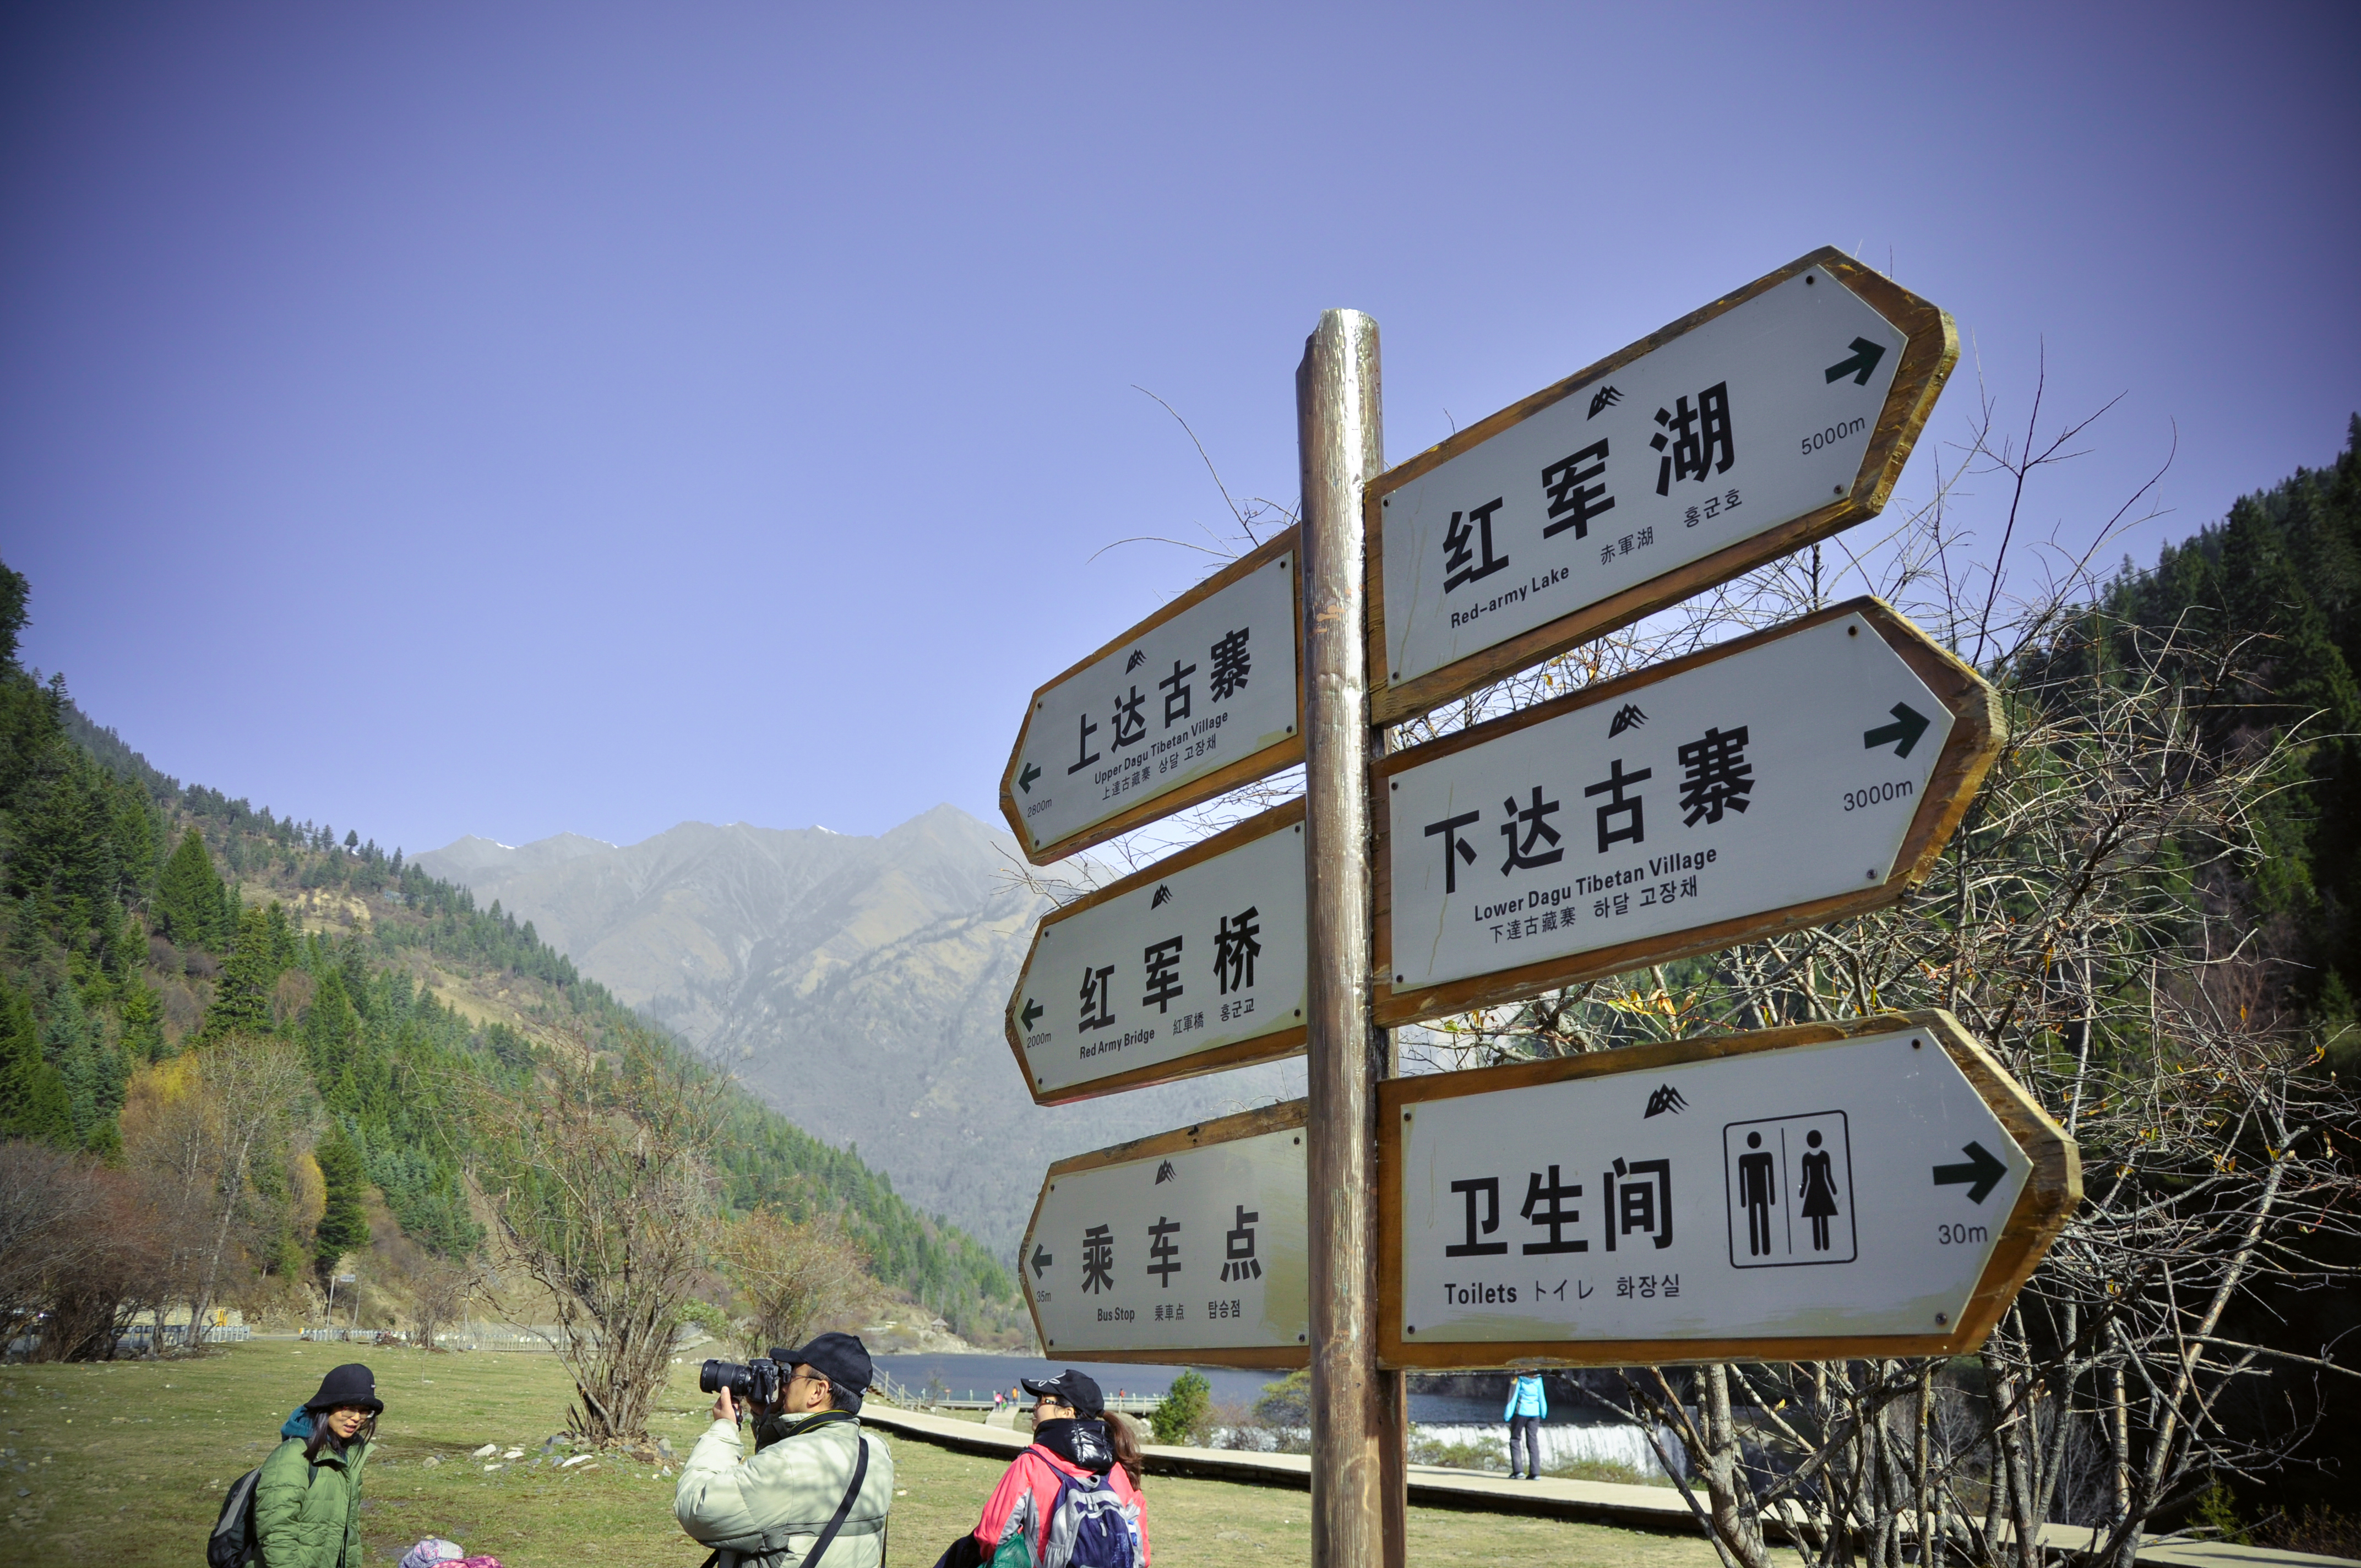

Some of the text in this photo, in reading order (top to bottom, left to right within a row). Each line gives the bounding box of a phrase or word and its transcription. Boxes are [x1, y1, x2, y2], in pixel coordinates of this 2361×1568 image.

[1802, 417, 1865, 455] 5000m
[1442, 380, 1735, 595] 红军湖
[1683, 488, 1742, 528] 홍군호
[1600, 526, 1653, 565] 赤軍湖
[1451, 567, 1569, 629] Red-army Lake
[1067, 626, 1252, 776] 上达古寨
[1095, 712, 1228, 785] Upper Dagu Tibetan Village
[1158, 733, 1216, 774] 상달 고장채
[1027, 798, 1052, 818] 2800m
[1424, 725, 1756, 895] 下达古寨
[1843, 780, 1913, 812] 3000m
[1475, 848, 1717, 922] Lower Dagu Tibetan Village
[1593, 874, 1697, 918] 하달 고장채
[1078, 905, 1262, 1034] 红军桥
[1173, 1011, 1204, 1036] 紅軍橋
[1220, 998, 1254, 1022] 홍군교
[1026, 1032, 1052, 1049] 2000m
[1080, 1028, 1155, 1060] Red Army Bridge
[1445, 1156, 1673, 1257] 卫生间
[1081, 1205, 1262, 1295] 乘车点
[1938, 1223, 1988, 1245] 30m
[1036, 1291, 1051, 1303] 35m
[1444, 1282, 1517, 1305] Toilets
[1536, 1279, 1593, 1302] トイレ
[1617, 1273, 1680, 1299] 화장실
[1097, 1306, 1135, 1324] Bus Stop
[1208, 1299, 1241, 1319] 탑승점
